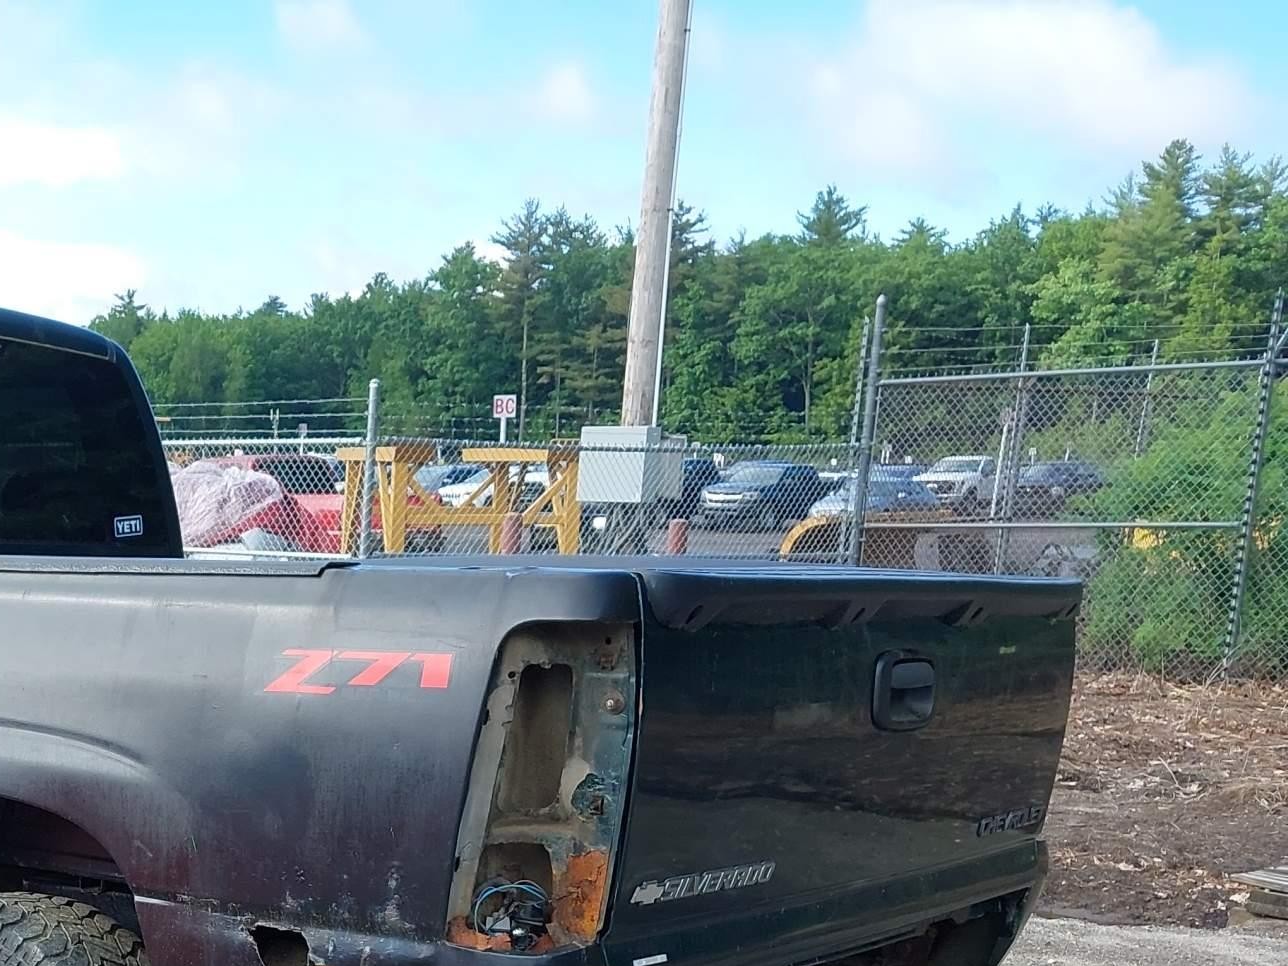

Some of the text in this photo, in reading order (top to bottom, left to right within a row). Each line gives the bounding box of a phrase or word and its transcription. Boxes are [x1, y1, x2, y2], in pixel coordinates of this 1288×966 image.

[495, 398, 515, 415] BC
[116, 519, 141, 534] YETI
[264, 648, 453, 696] Z71
[662, 861, 776, 901] SILVERADO
